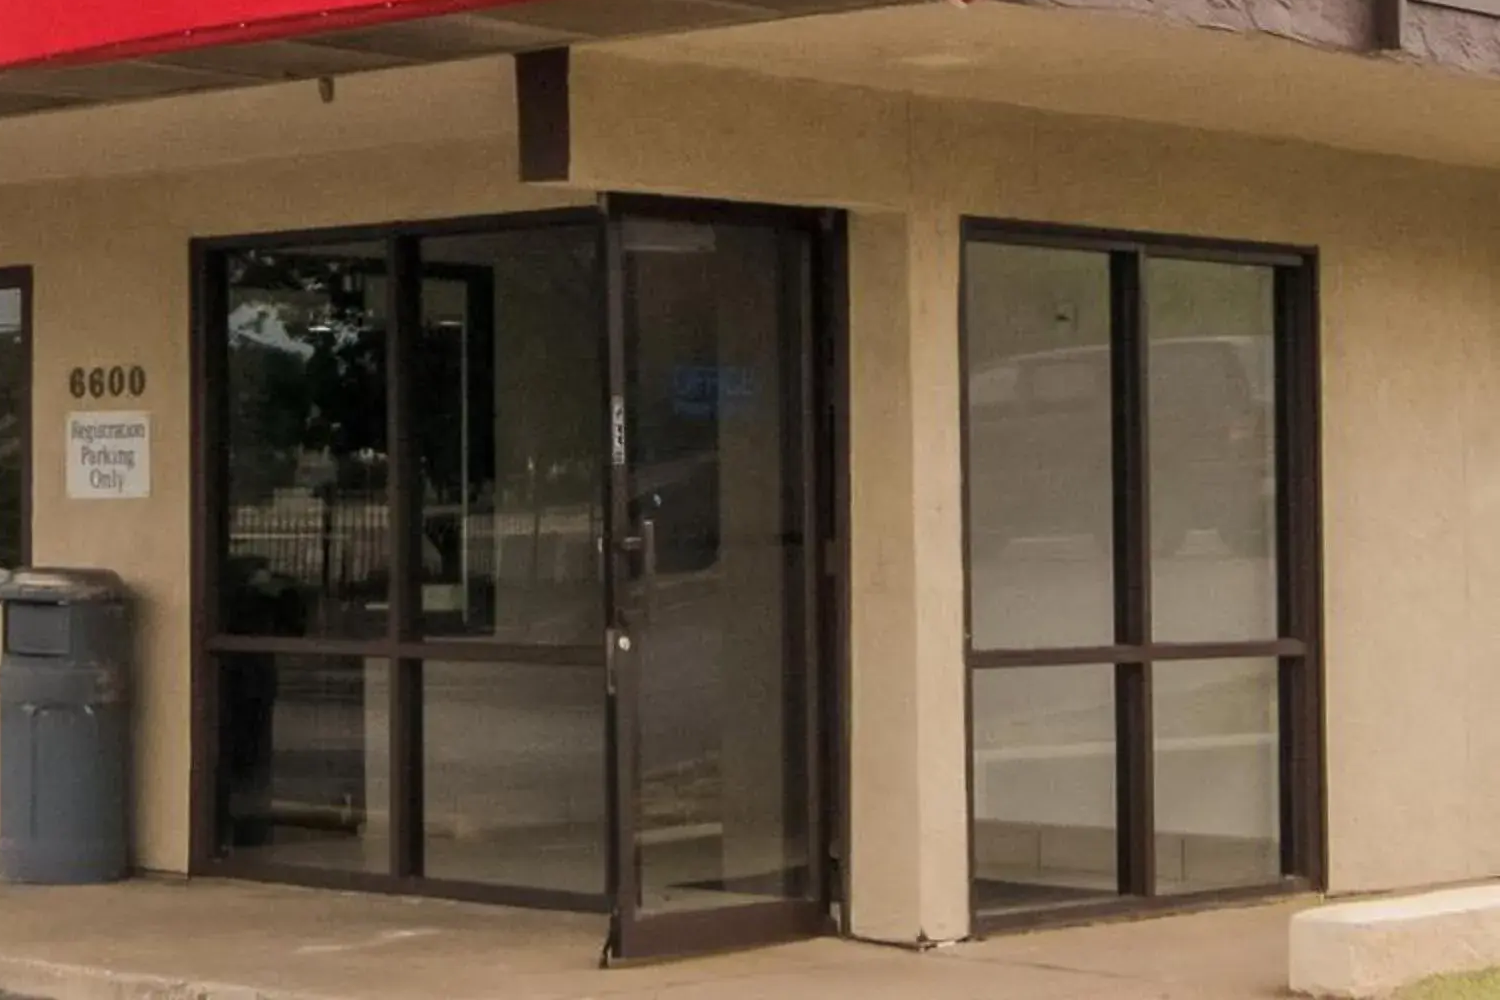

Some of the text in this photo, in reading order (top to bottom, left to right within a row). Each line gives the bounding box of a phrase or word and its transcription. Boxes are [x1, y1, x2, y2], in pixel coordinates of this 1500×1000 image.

[69, 365, 147, 399] 6600
[70, 420, 146, 443] Registration
[80, 446, 136, 471] Parking
[89, 467, 125, 494] Only
